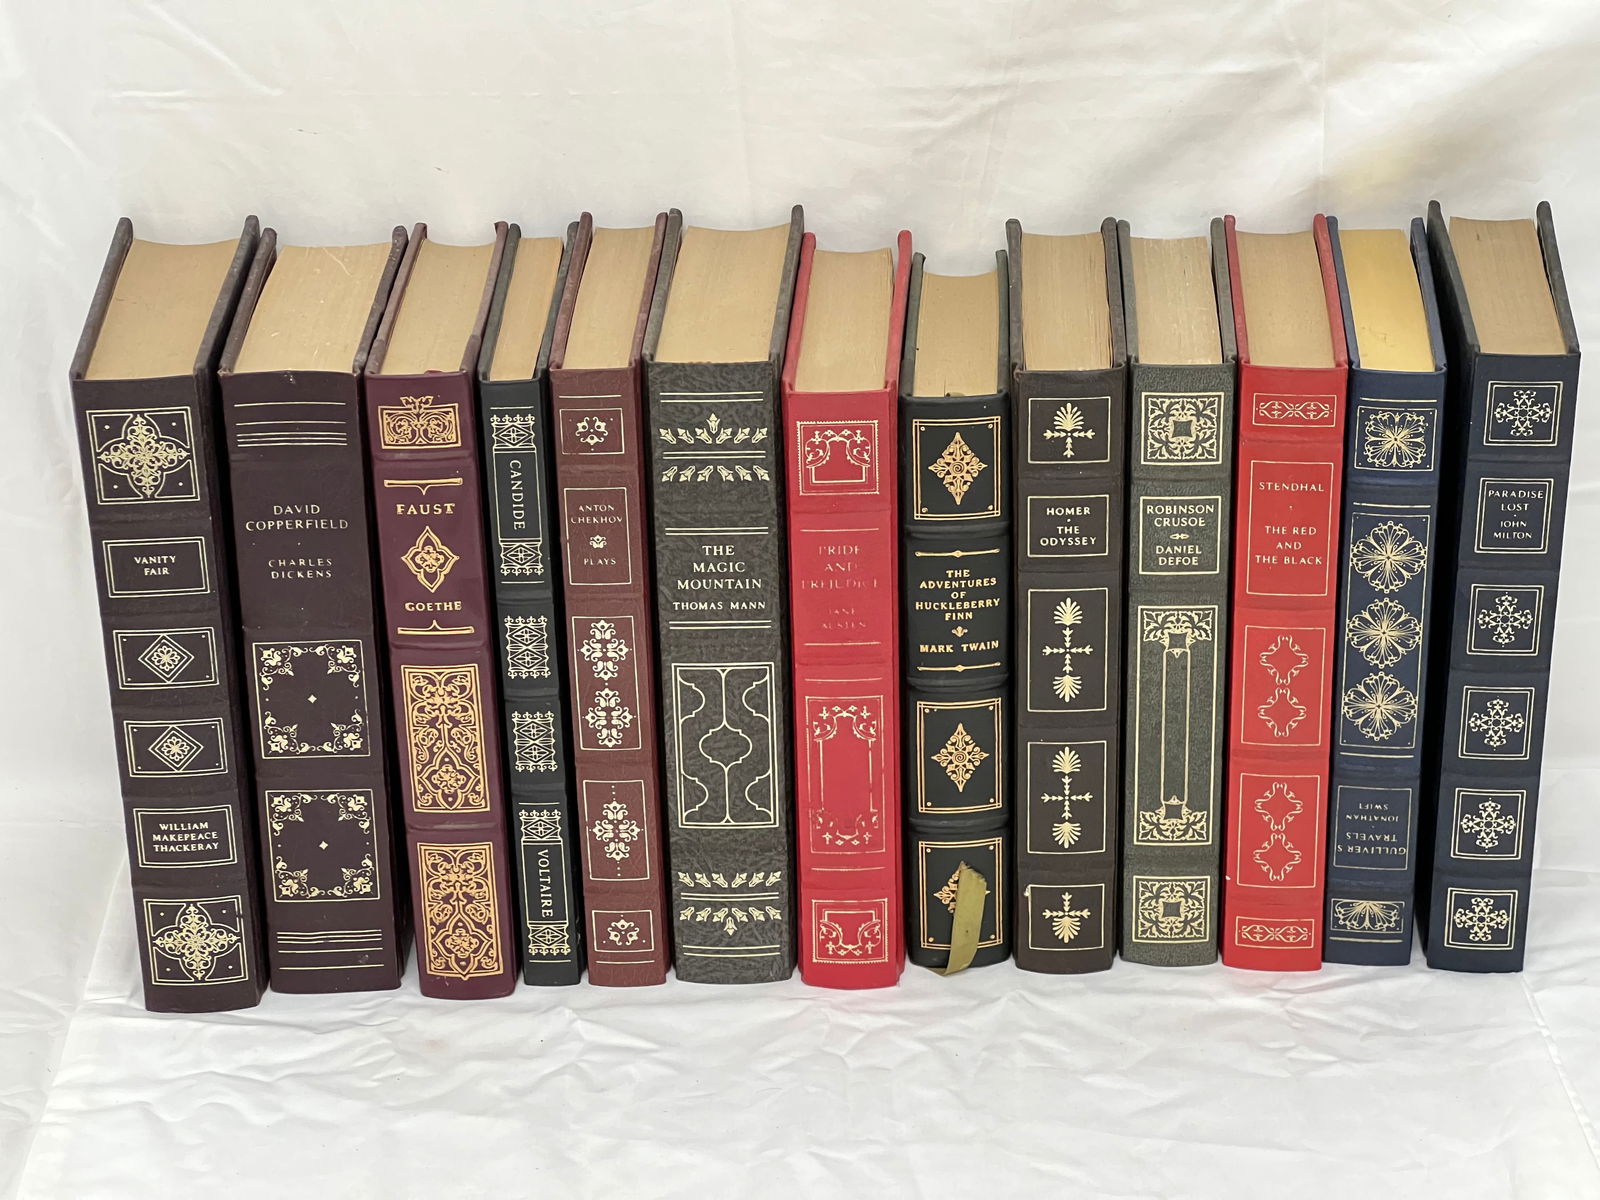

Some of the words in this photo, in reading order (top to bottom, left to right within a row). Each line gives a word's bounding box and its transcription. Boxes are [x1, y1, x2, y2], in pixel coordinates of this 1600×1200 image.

[1259, 482, 1324, 492] STENDHAL
[510, 460, 526, 530] CANDIDE
[1488, 490, 1544, 498] PARADISE
[273, 504, 320, 516] DAVID
[396, 503, 456, 514] FAUST
[1046, 506, 1090, 516] HOMER
[1146, 504, 1214, 514] ROBINSON
[246, 520, 348, 531] COPPERFIELD
[1154, 518, 1206, 526] CRUSOE
[1056, 526, 1080, 534] THE
[1264, 526, 1287, 534] THE
[1292, 526, 1316, 535] RED
[1040, 536, 1096, 546] ODYSSEY
[1276, 542, 1302, 550] AND
[702, 545, 734, 556] THE
[1156, 546, 1202, 554] DANIEL
[134, 556, 176, 564] VANITY
[268, 558, 332, 568] CHARLES
[1158, 556, 1198, 566] DEFOE
[1255, 555, 1278, 564] THE
[1284, 556, 1322, 564] BLACK
[144, 568, 170, 576] FAIR
[693, 562, 746, 572] MAGIC
[271, 570, 332, 579] DICKENS
[946, 570, 970, 578] THE
[677, 579, 762, 590] MOUNTAIN
[920, 578, 997, 589] ADVENTURES
[950, 592, 966, 600] OF
[404, 601, 462, 611] GOETHE
[673, 602, 723, 610] THOMAS
[730, 602, 766, 610] MANN
[915, 598, 1000, 610] HUCKLEBERRY
[944, 612, 973, 620] FINN
[920, 644, 954, 652] MARK
[961, 640, 999, 652] TWAIN
[159, 822, 209, 830] WILLIAM
[152, 832, 218, 842] MAKEPEACE
[1346, 832, 1397, 842] TRAVELS
[152, 842, 219, 852] THACKERAY
[538, 850, 554, 918] VOLTAIRE
